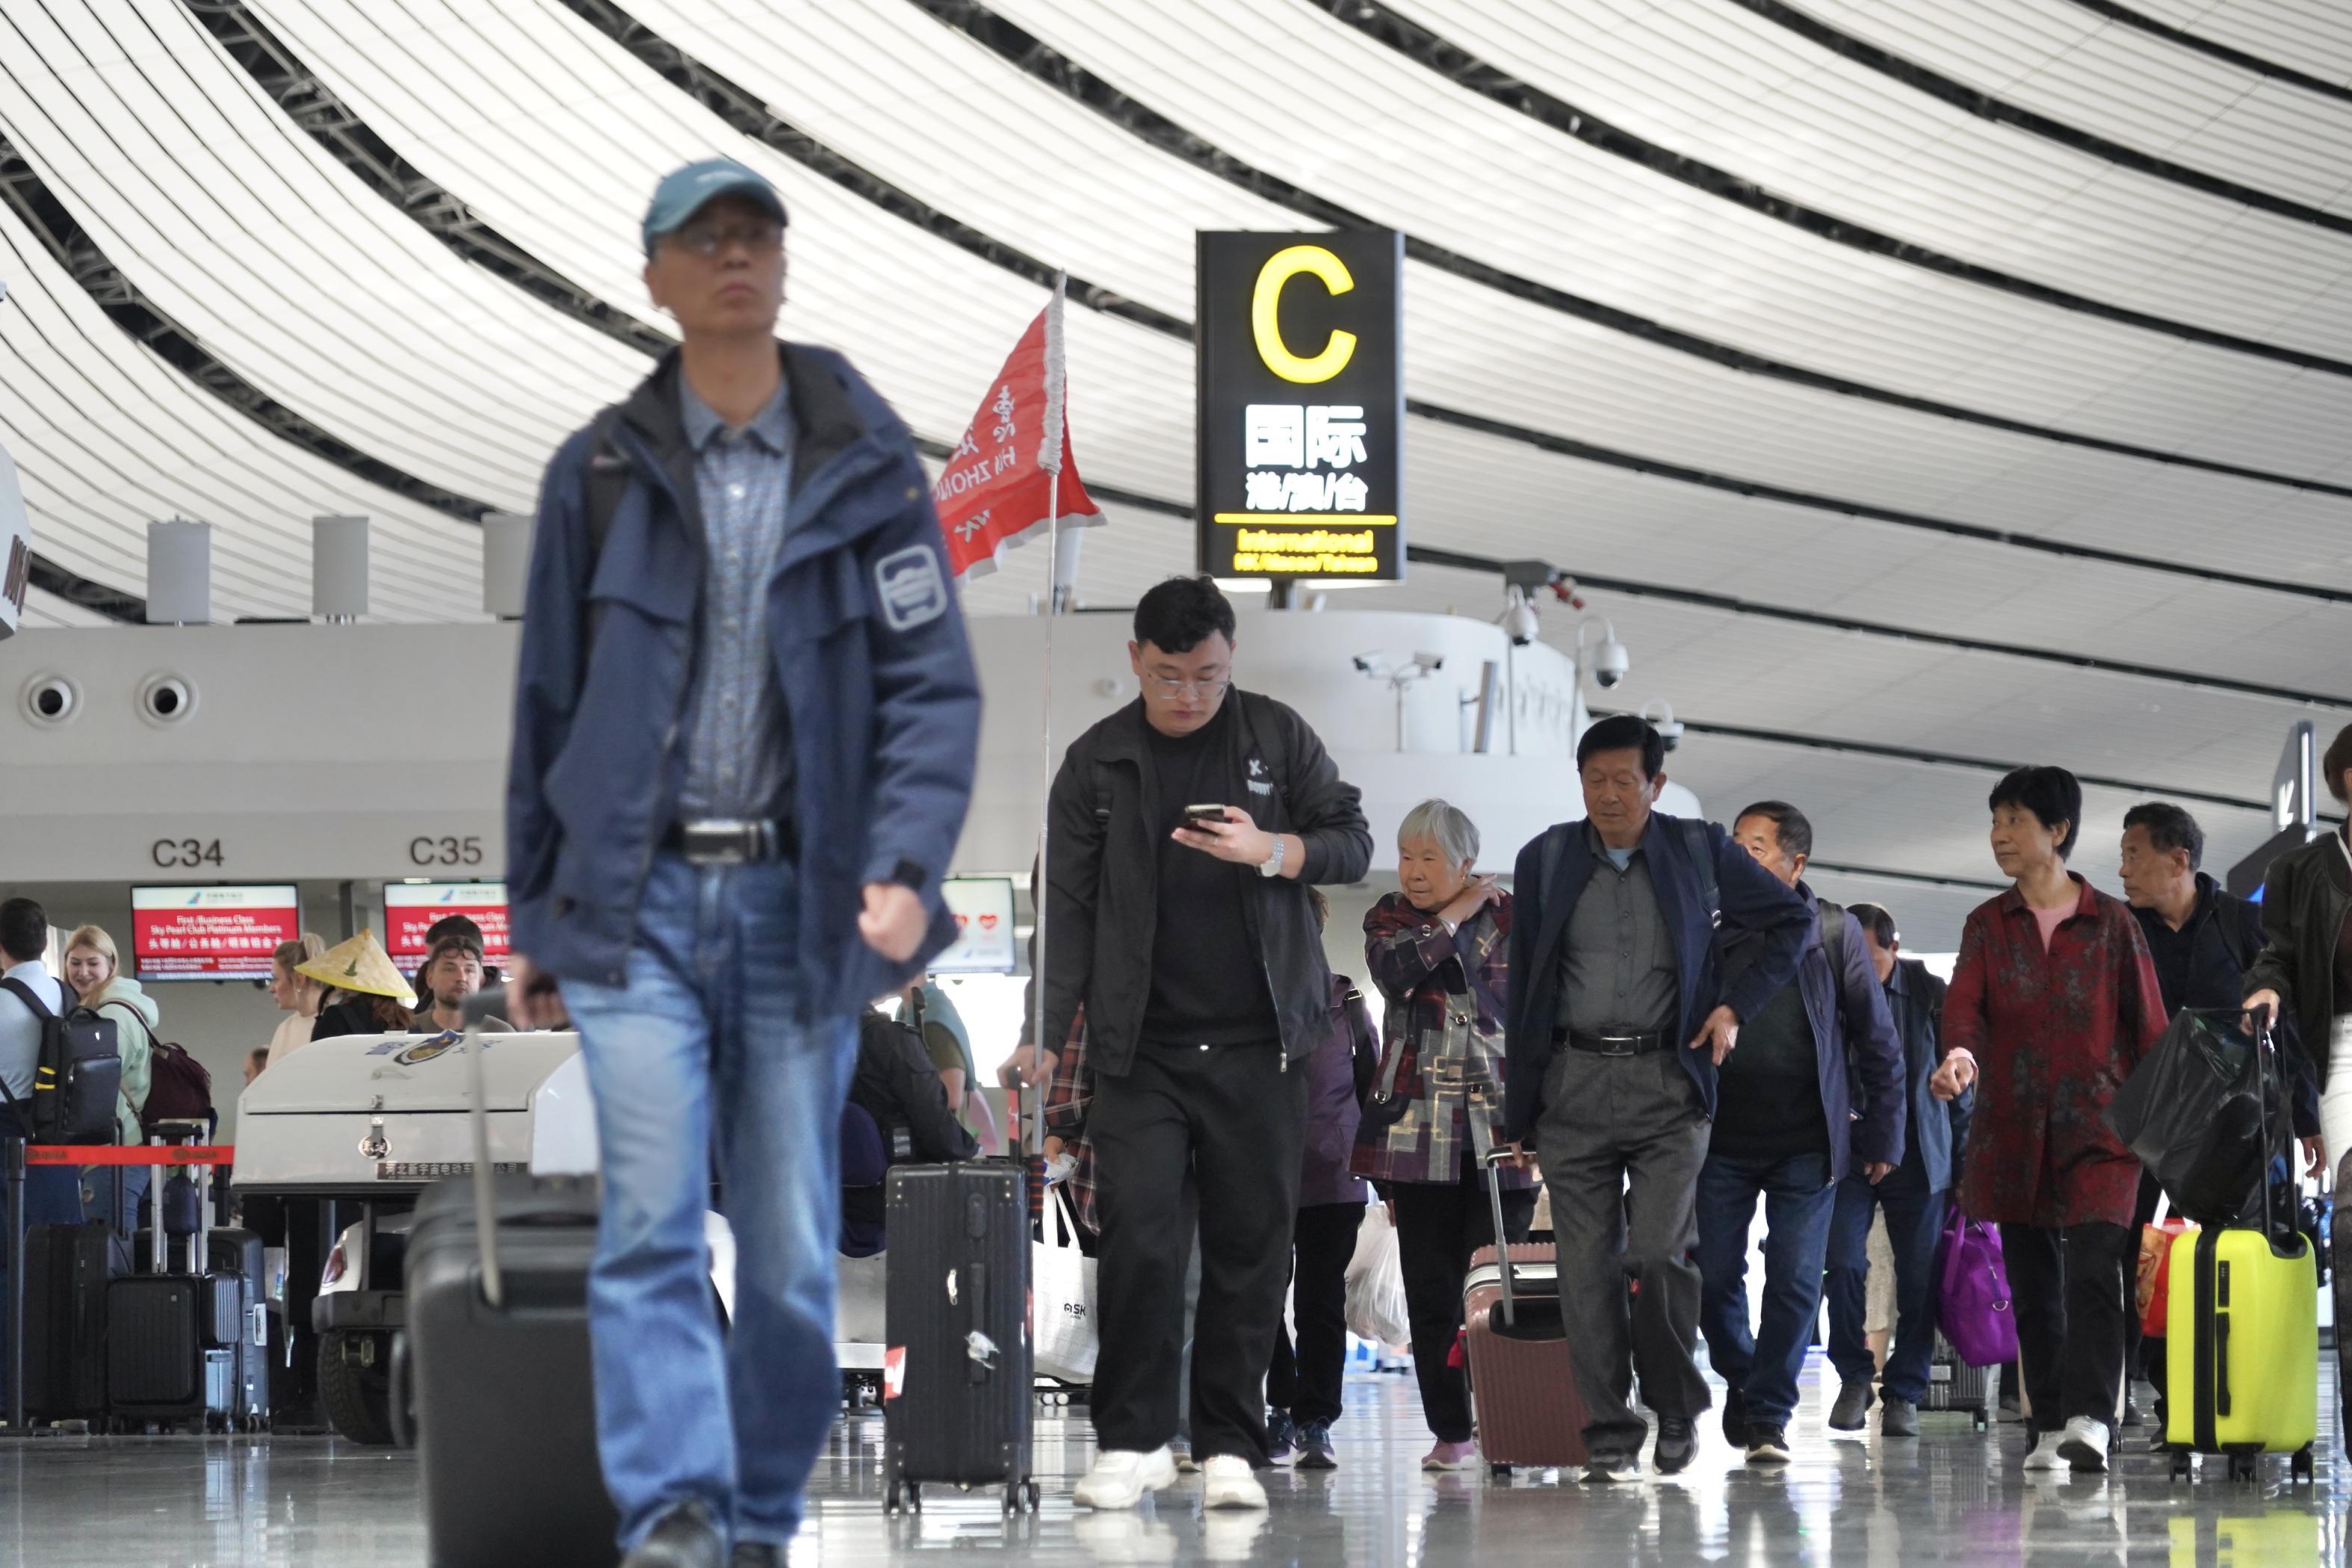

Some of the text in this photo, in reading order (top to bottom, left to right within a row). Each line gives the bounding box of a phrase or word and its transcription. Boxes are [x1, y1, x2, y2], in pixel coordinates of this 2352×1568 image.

[1251, 245, 1358, 384] C
[1245, 404, 1368, 469] 国际
[1237, 528, 1374, 554] International
[152, 839, 225, 867] C34
[410, 837, 482, 865] C35
[150, 923, 282, 936] Sky Pearl Club Platinum Members
[232, 914, 255, 925] Class
